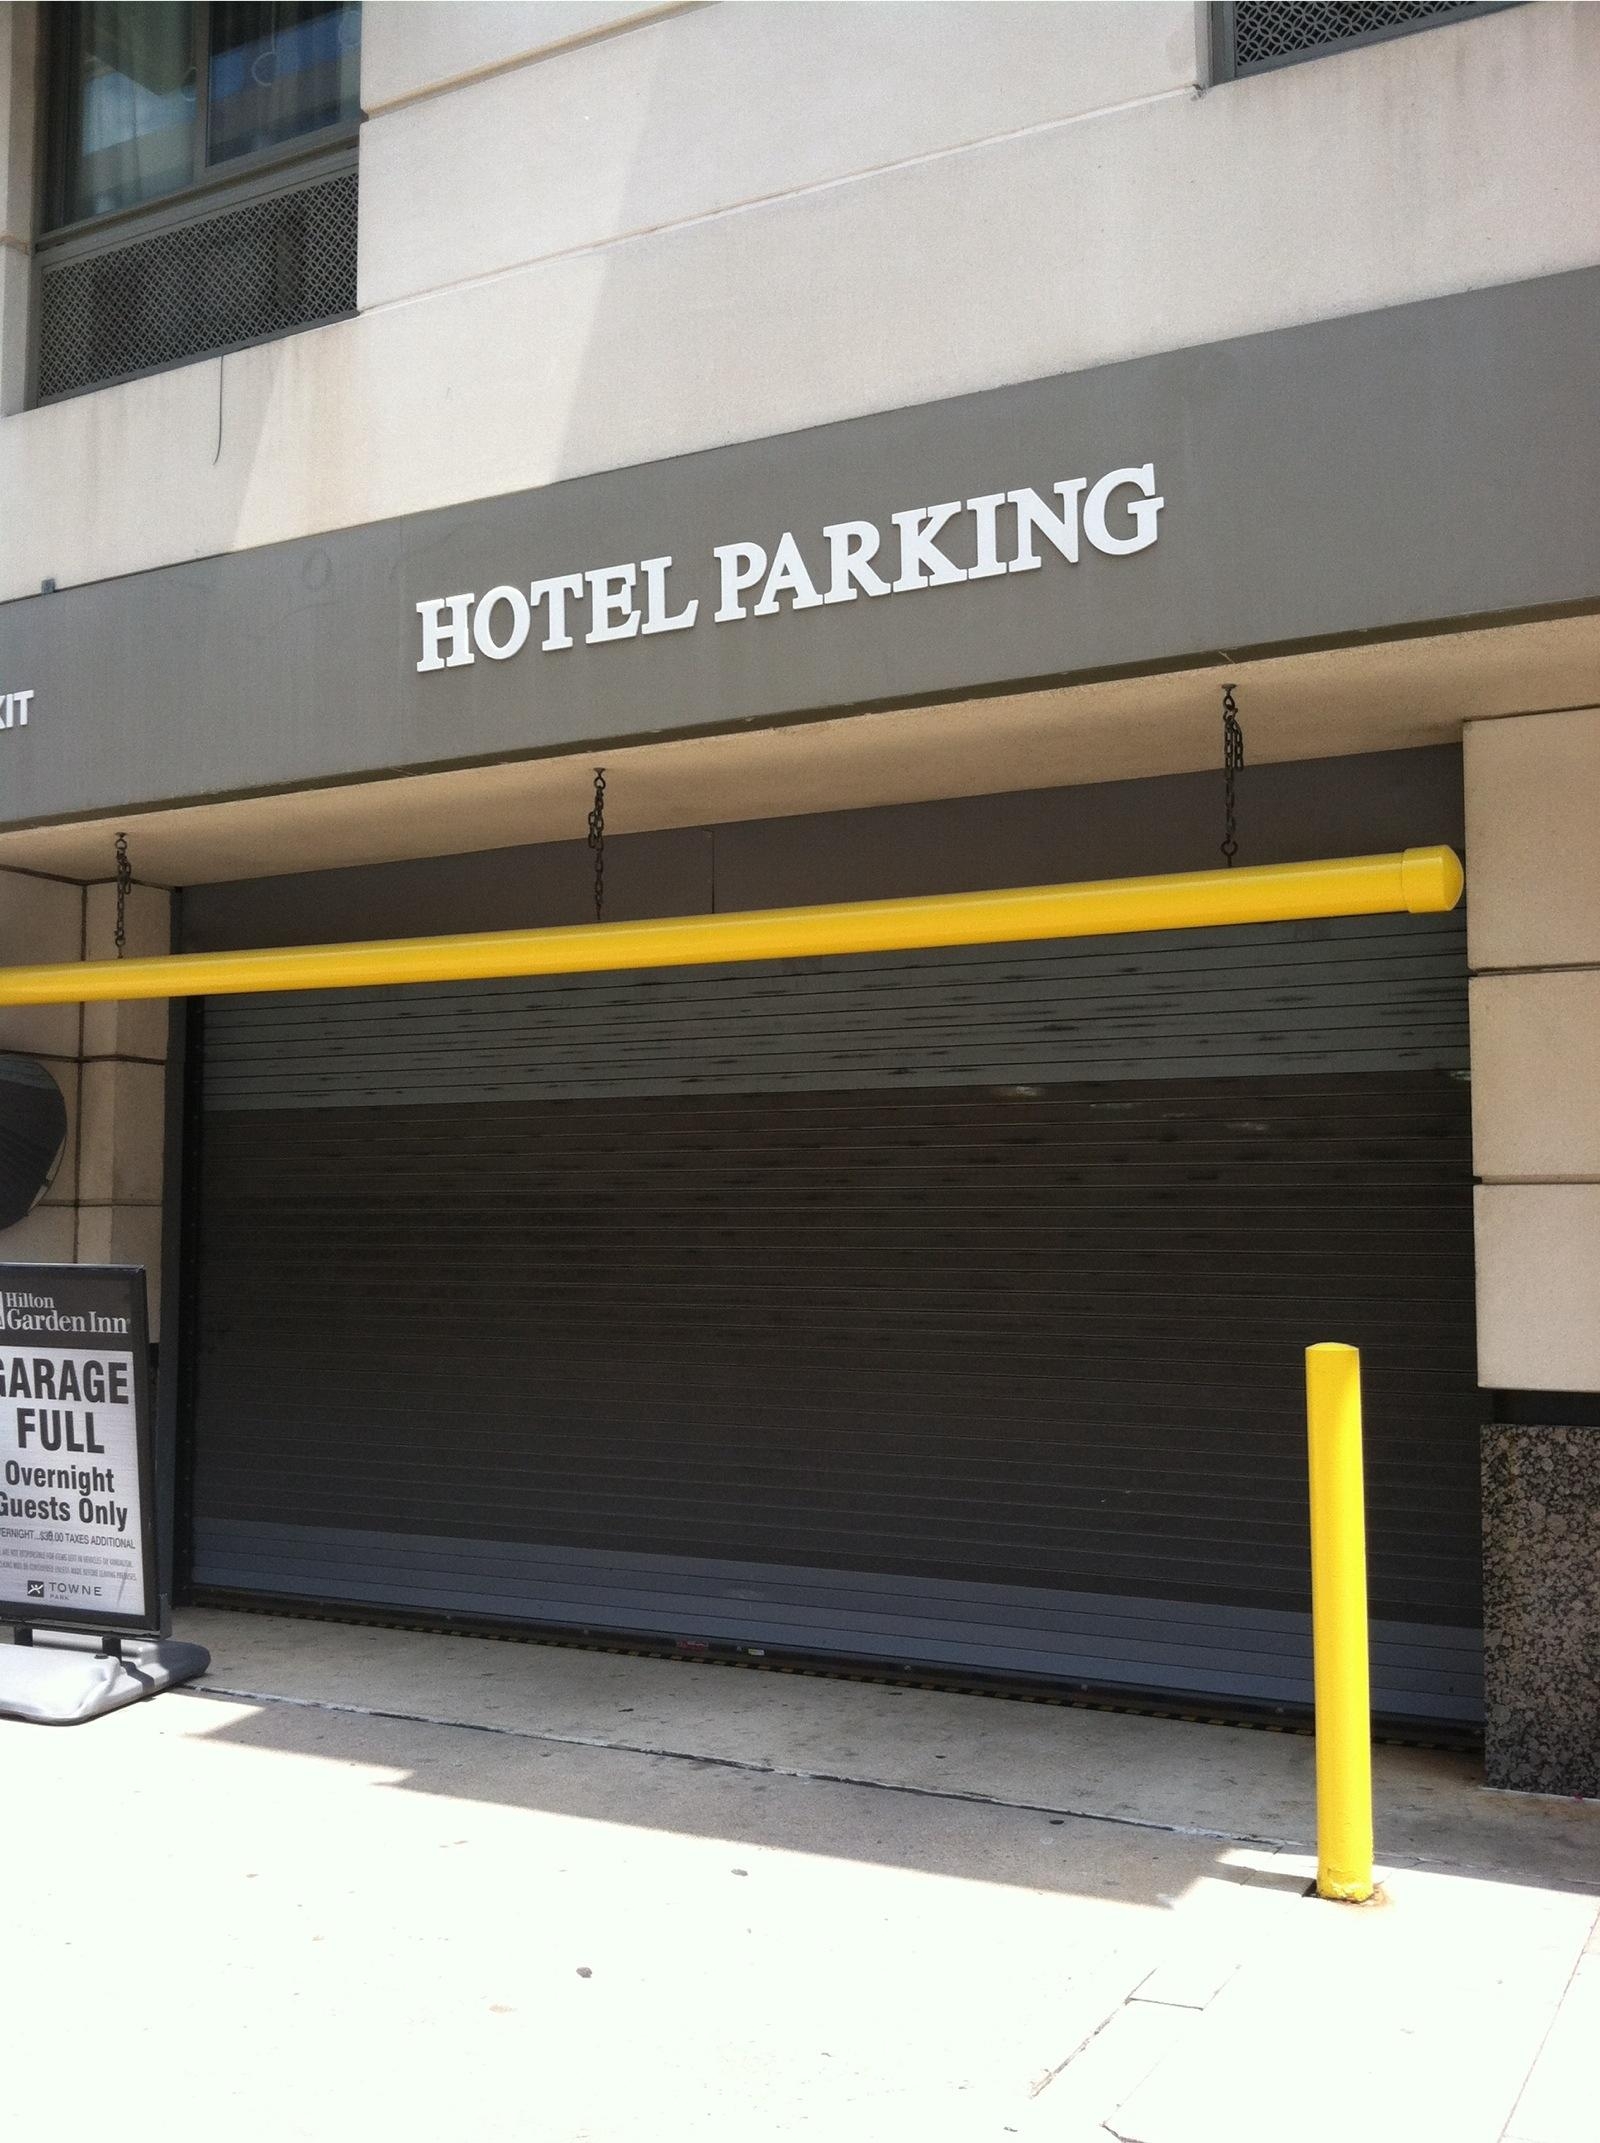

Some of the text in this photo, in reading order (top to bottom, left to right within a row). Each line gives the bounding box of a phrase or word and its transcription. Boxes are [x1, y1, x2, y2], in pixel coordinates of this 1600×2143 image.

[416, 463, 1165, 673] HOTEL PARKING
[6, 1292, 55, 1309] Hilton
[7, 1308, 129, 1334] Garden Inn
[17, 1407, 105, 1454] FULL
[5, 1459, 115, 1497] Overnight
[79, 1497, 128, 1532] Only
[65, 1532, 90, 1545] TAXES
[90, 1535, 136, 1550] ADDITIONAL
[48, 1581, 103, 1597] TOWNE
